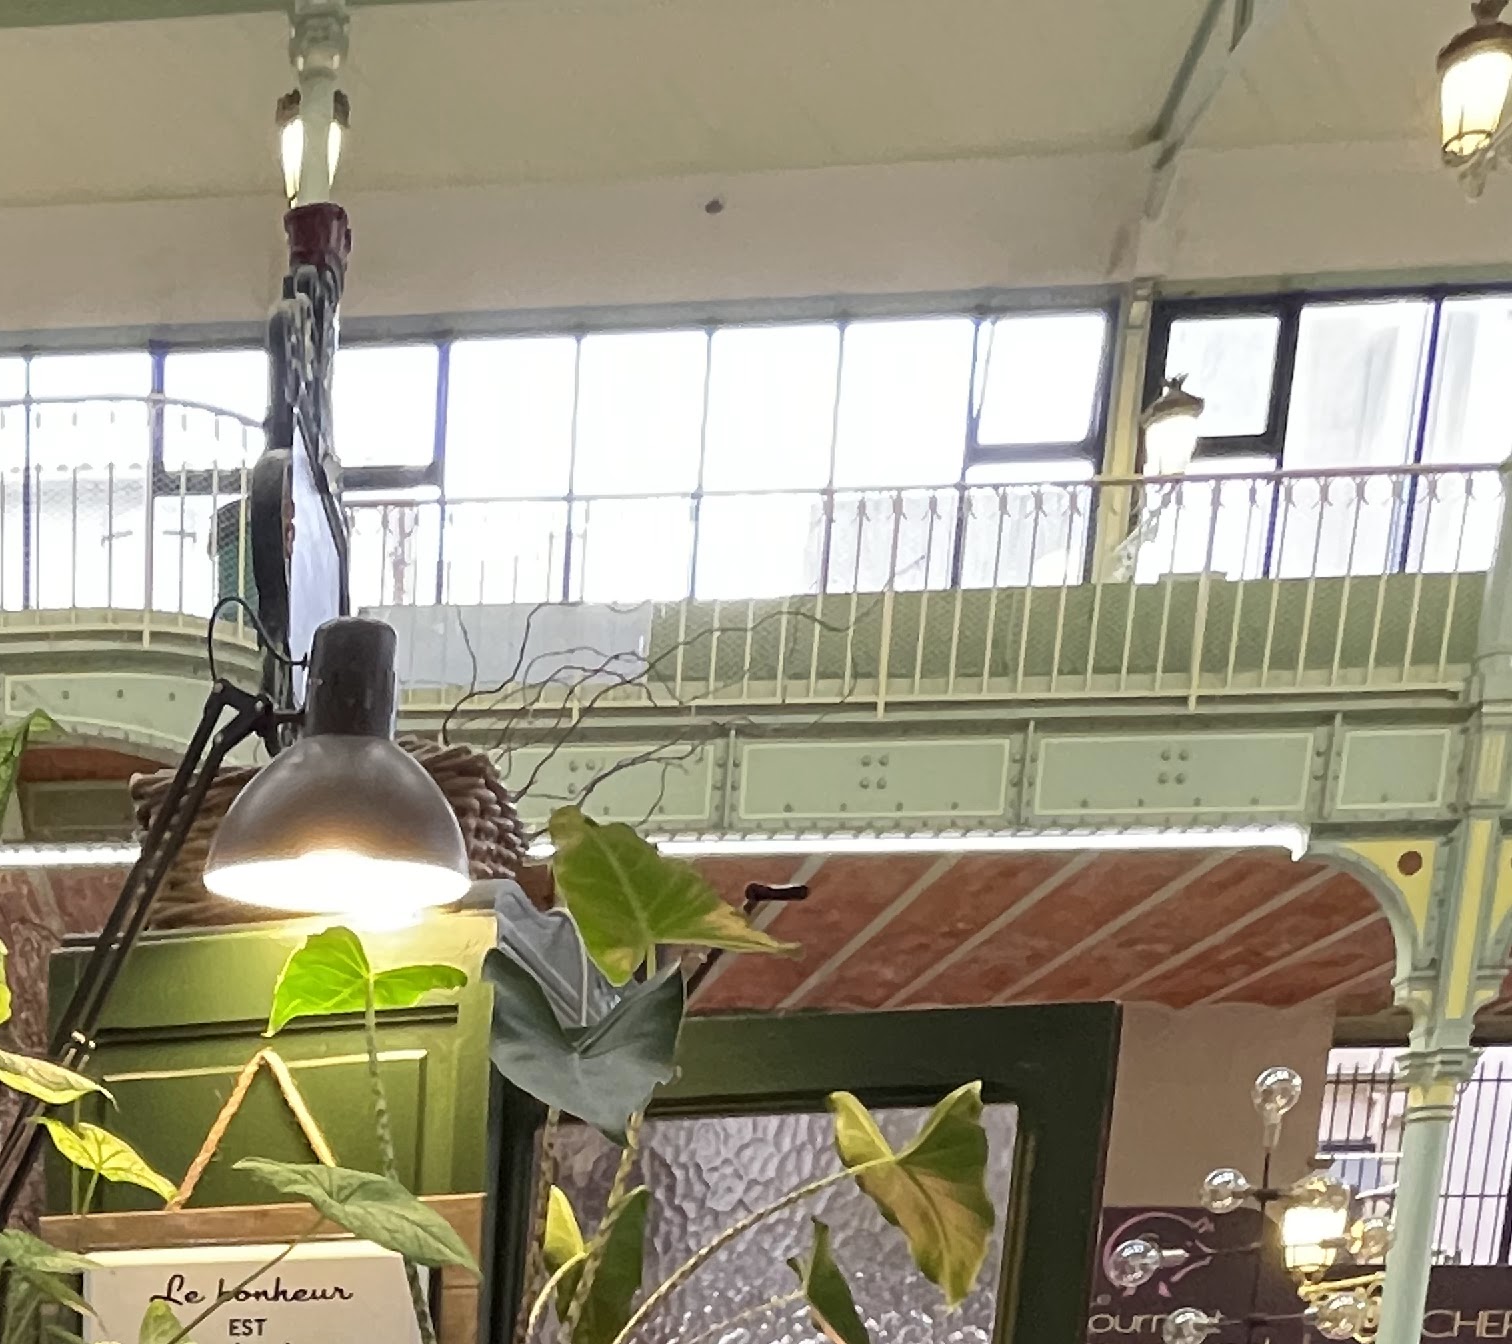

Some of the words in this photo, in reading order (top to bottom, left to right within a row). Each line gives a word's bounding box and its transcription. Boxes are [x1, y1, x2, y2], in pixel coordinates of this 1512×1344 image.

[149, 1274, 205, 1306] Le
[215, 1276, 354, 1303] bonheur
[228, 1318, 267, 1337] EST
